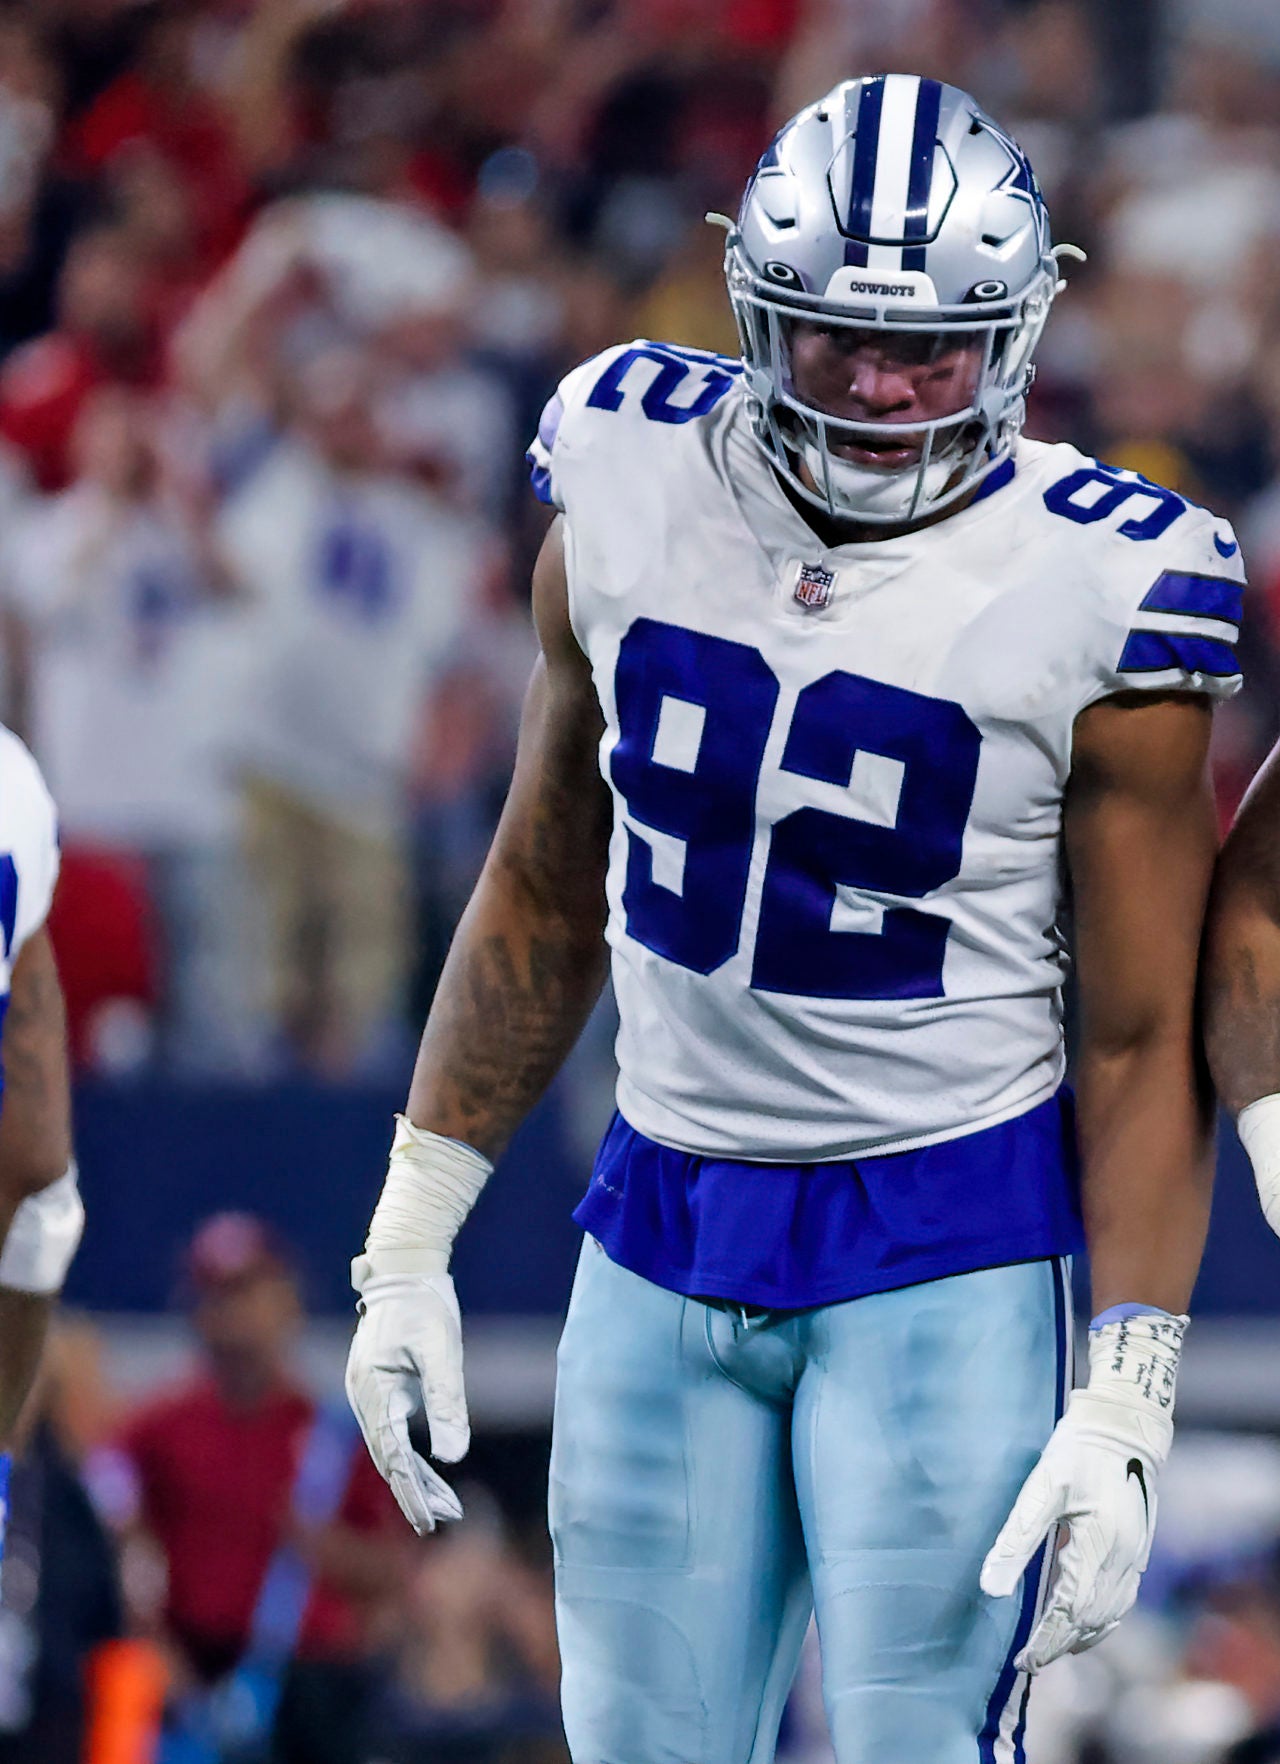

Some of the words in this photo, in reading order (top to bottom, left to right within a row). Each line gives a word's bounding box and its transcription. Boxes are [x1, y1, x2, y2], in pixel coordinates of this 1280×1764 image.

[850, 281, 915, 297] COWBOYS
[586, 341, 745, 425] 2
[1042, 458, 1202, 541] 9
[798, 580, 826, 603] NFL
[610, 616, 984, 999] 92
